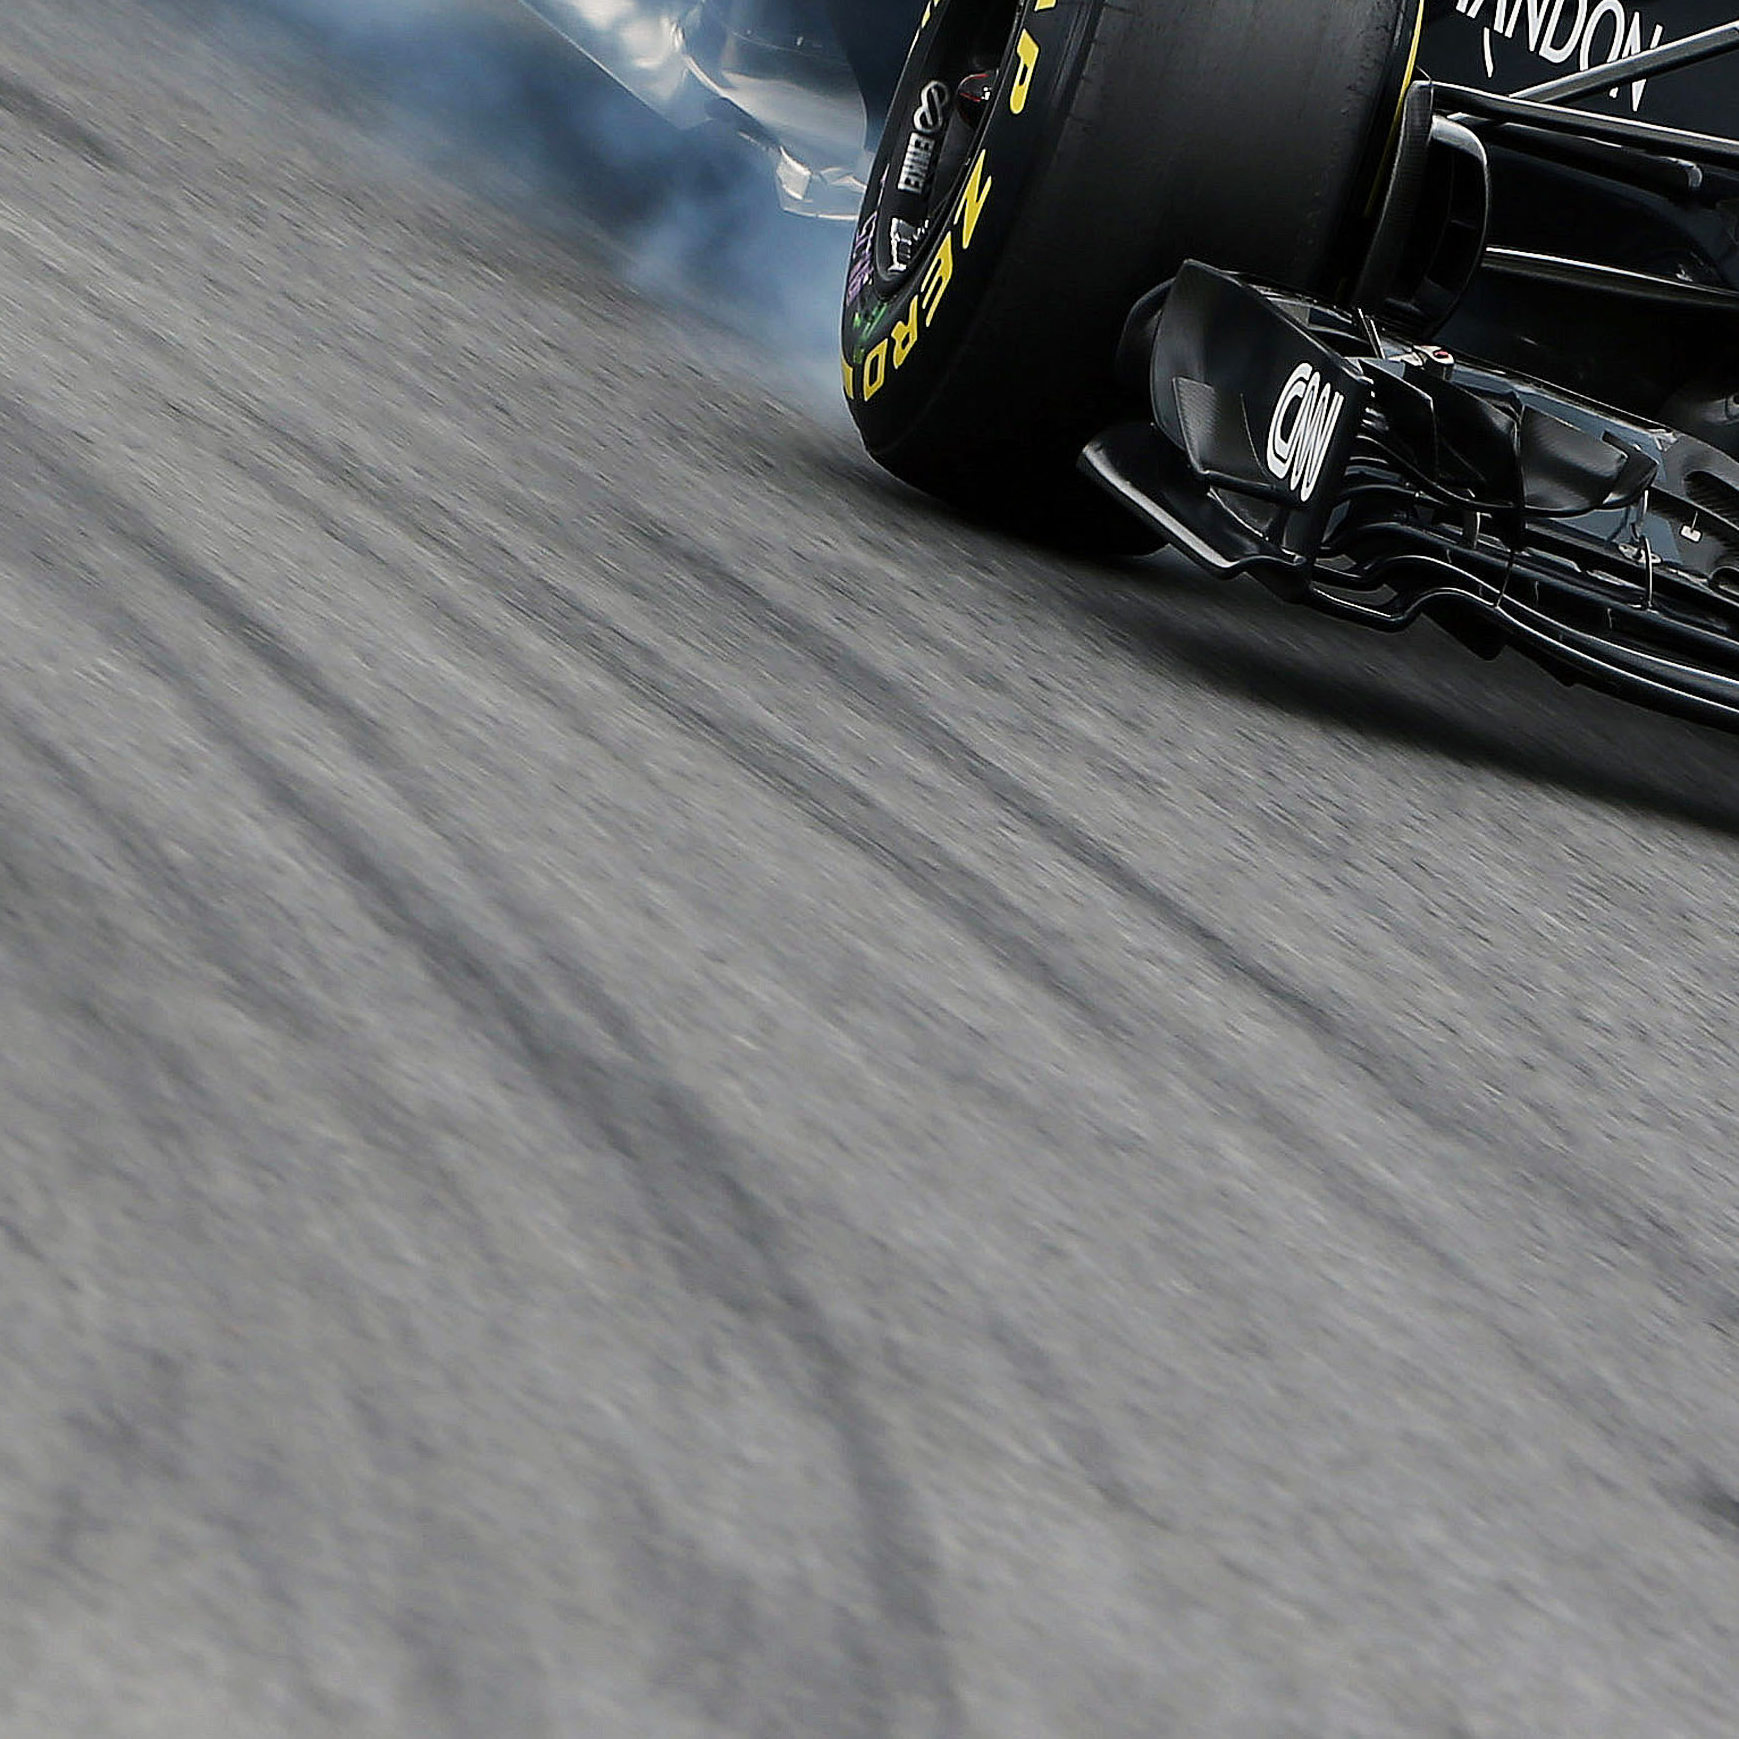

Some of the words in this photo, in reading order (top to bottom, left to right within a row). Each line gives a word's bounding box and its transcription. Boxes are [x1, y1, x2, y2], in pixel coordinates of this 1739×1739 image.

[1009, 27, 1040, 115] P
[861, 147, 993, 402] ZERO
[1266, 362, 1345, 502] CNN
